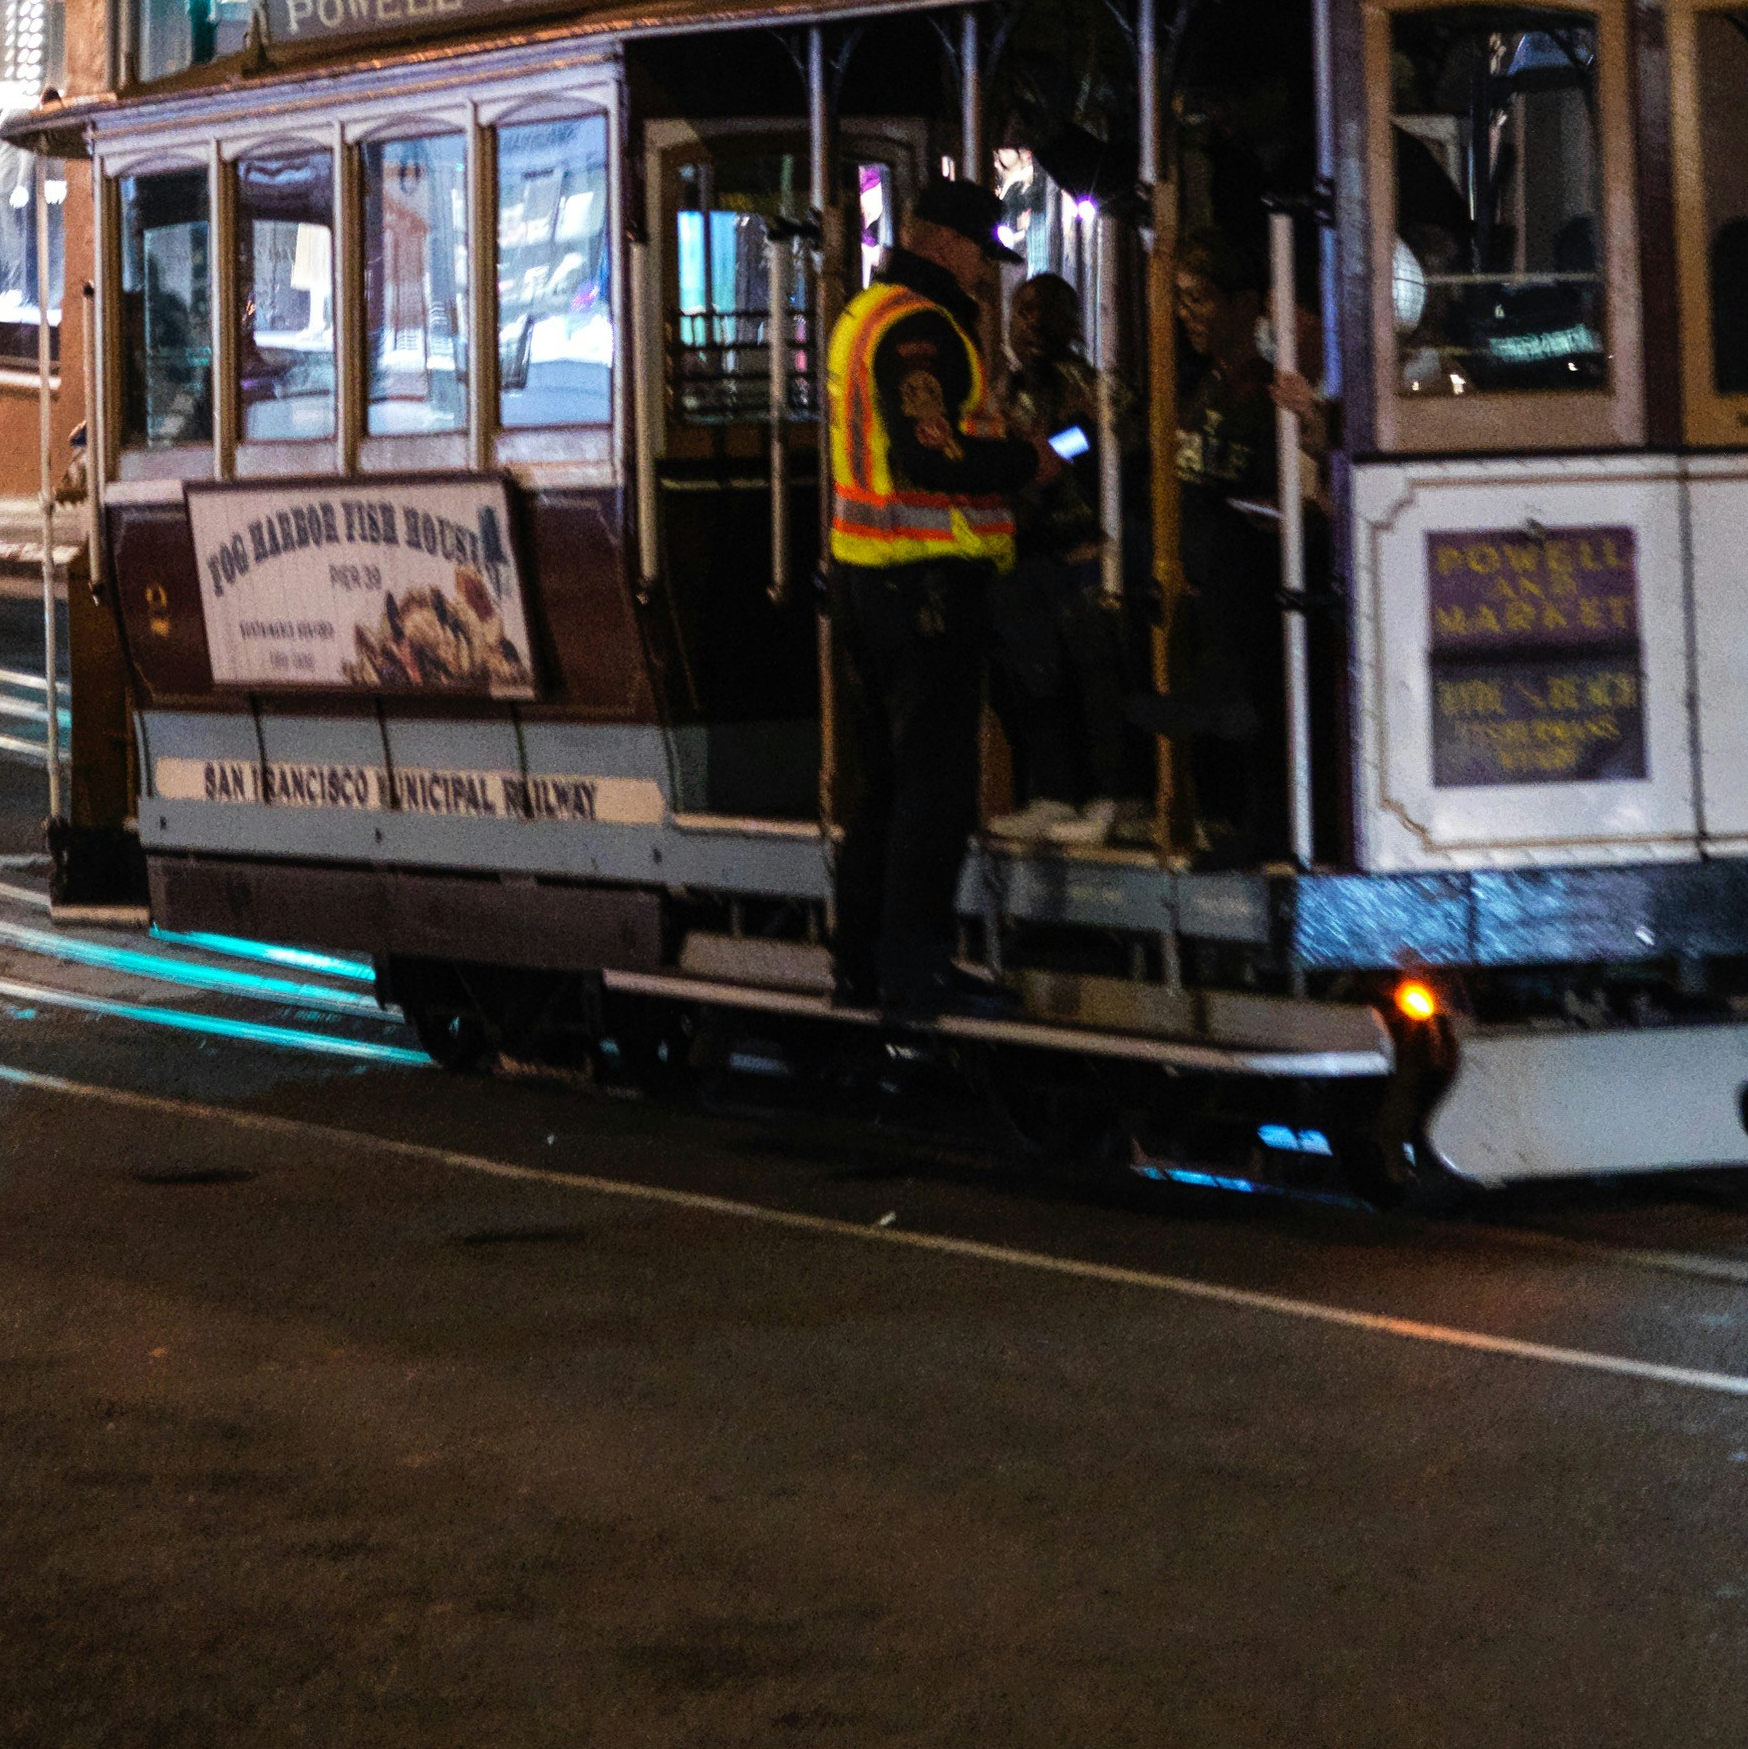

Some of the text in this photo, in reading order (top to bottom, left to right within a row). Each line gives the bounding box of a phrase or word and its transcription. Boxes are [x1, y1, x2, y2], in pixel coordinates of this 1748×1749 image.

[207, 532, 250, 598] FOG
[248, 502, 339, 564] HARBOR
[341, 500, 399, 545] FISH
[1436, 537, 1629, 577] POWELL
[1435, 596, 1633, 636] MARKET
[204, 760, 245, 801] SAN
[252, 764, 369, 806] FRANCISCO
